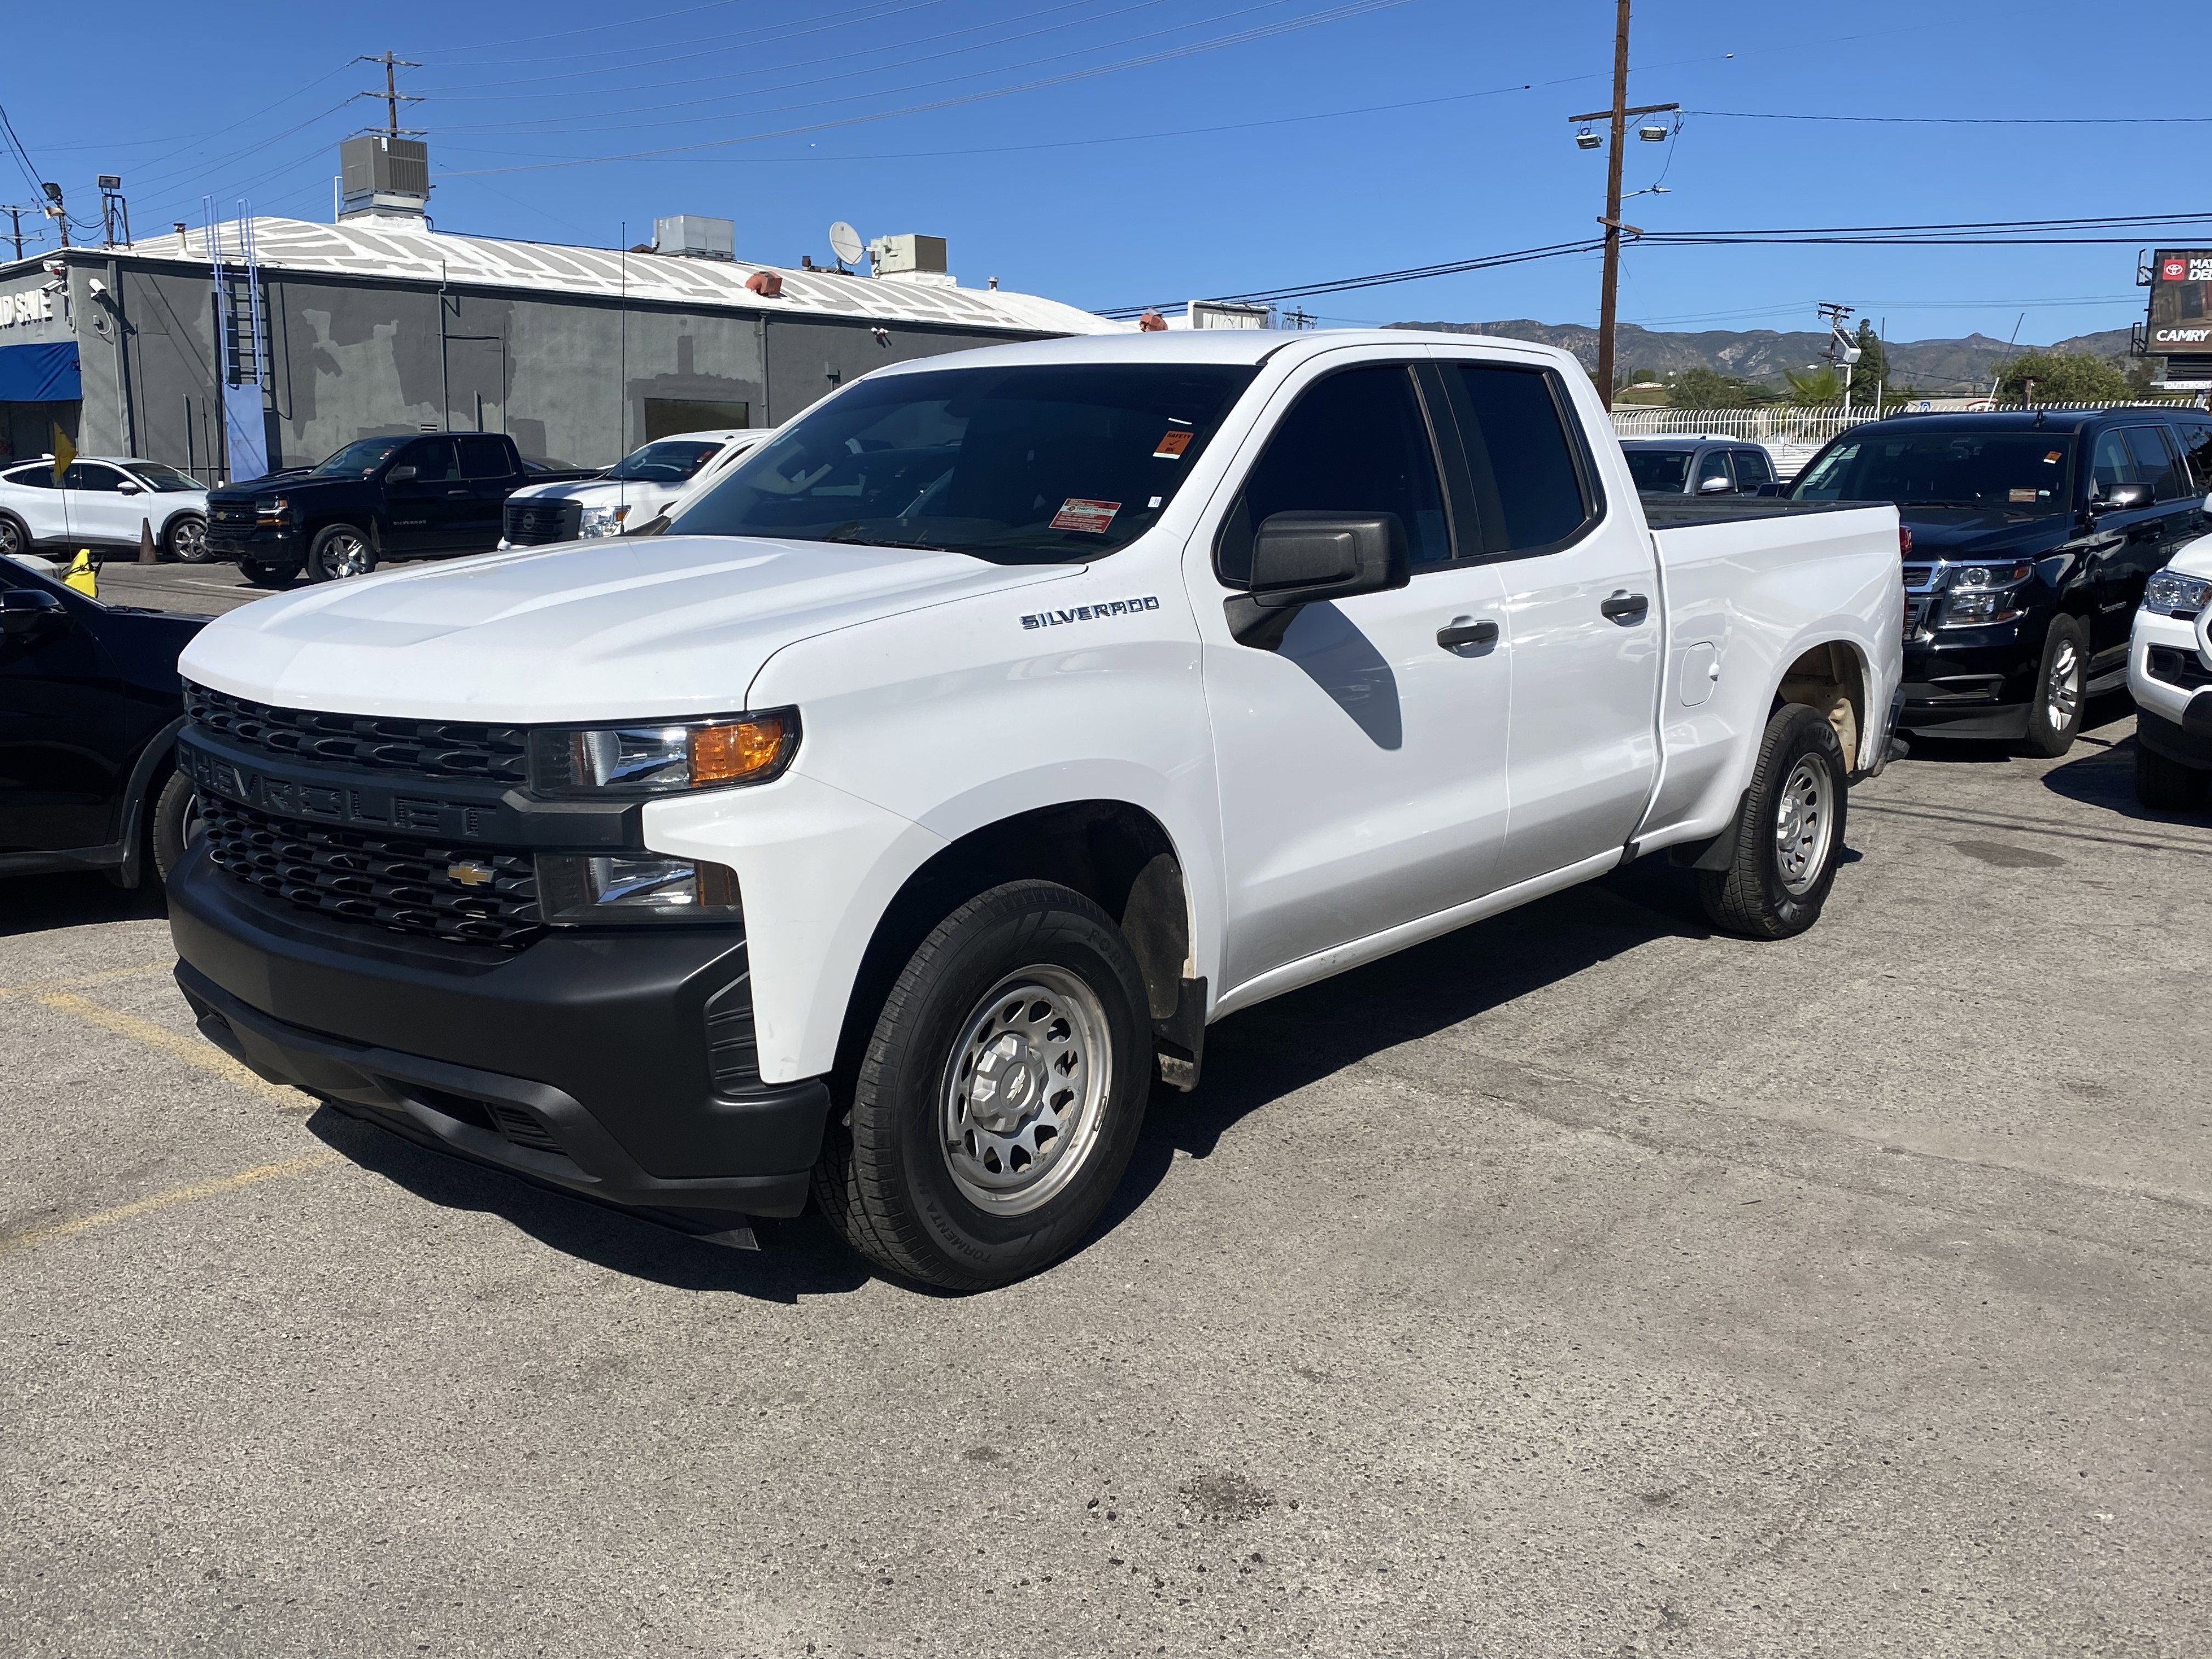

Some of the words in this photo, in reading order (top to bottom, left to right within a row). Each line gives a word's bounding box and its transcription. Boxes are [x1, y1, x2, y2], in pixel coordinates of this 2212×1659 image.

[2156, 330, 2210, 341] CAMRY
[1019, 596, 1159, 629] SILVERADO
[178, 743, 496, 837] CHEVROLET
